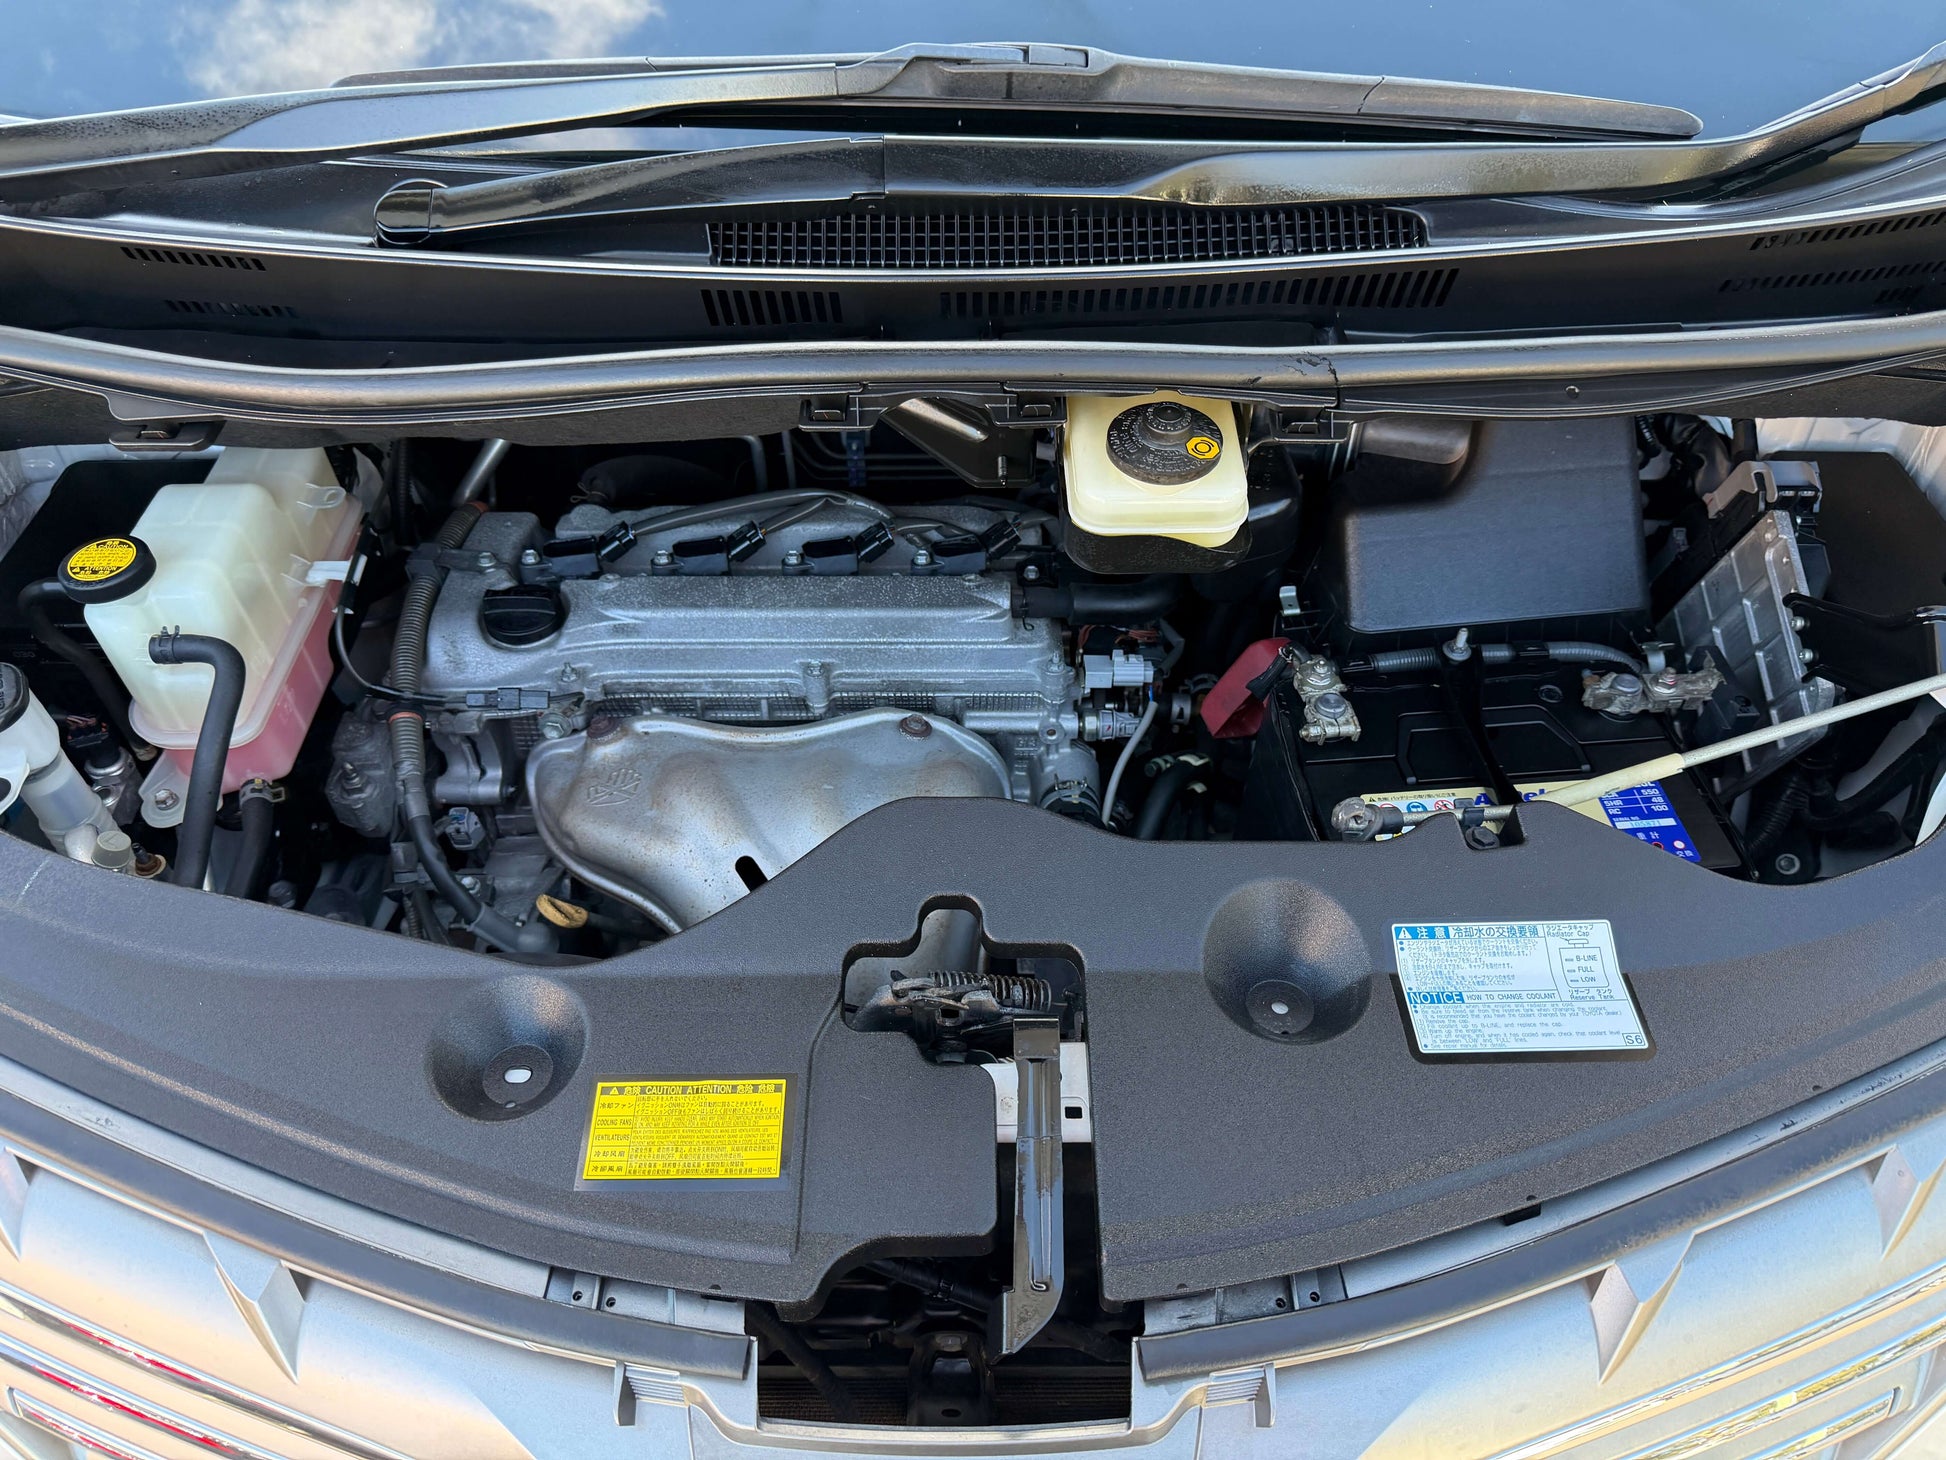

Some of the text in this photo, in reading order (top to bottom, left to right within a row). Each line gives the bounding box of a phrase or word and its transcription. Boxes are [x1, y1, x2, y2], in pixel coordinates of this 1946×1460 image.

[1416, 926, 1448, 939] 注意
[1410, 992, 1460, 1003] NOTICE
[1626, 1035, 1643, 1045] S6
[646, 1086, 682, 1095] CAUTION
[686, 1085, 732, 1094] ATTENTION
